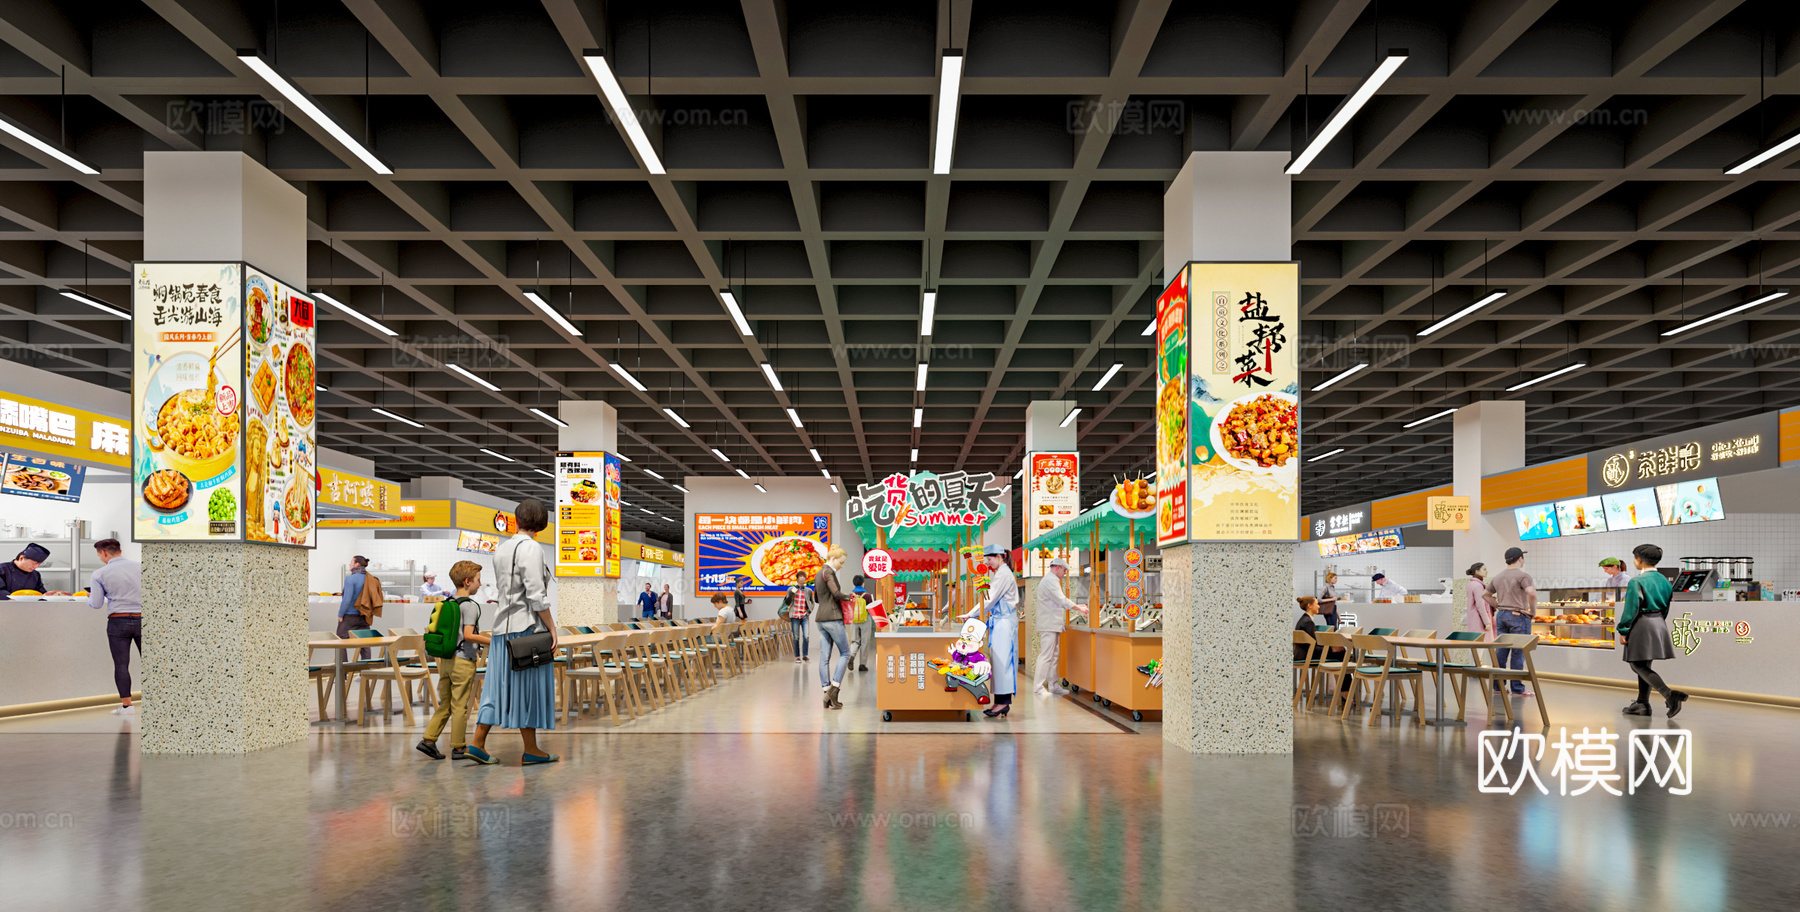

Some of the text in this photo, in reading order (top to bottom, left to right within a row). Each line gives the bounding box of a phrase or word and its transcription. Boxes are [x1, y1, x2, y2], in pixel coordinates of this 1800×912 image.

[153, 283, 222, 304] 焖锅觅春食
[153, 305, 222, 327] 舌尖游山海
[846, 470, 1003, 527] 吃货的夏天
[905, 510, 988, 526] Summer
